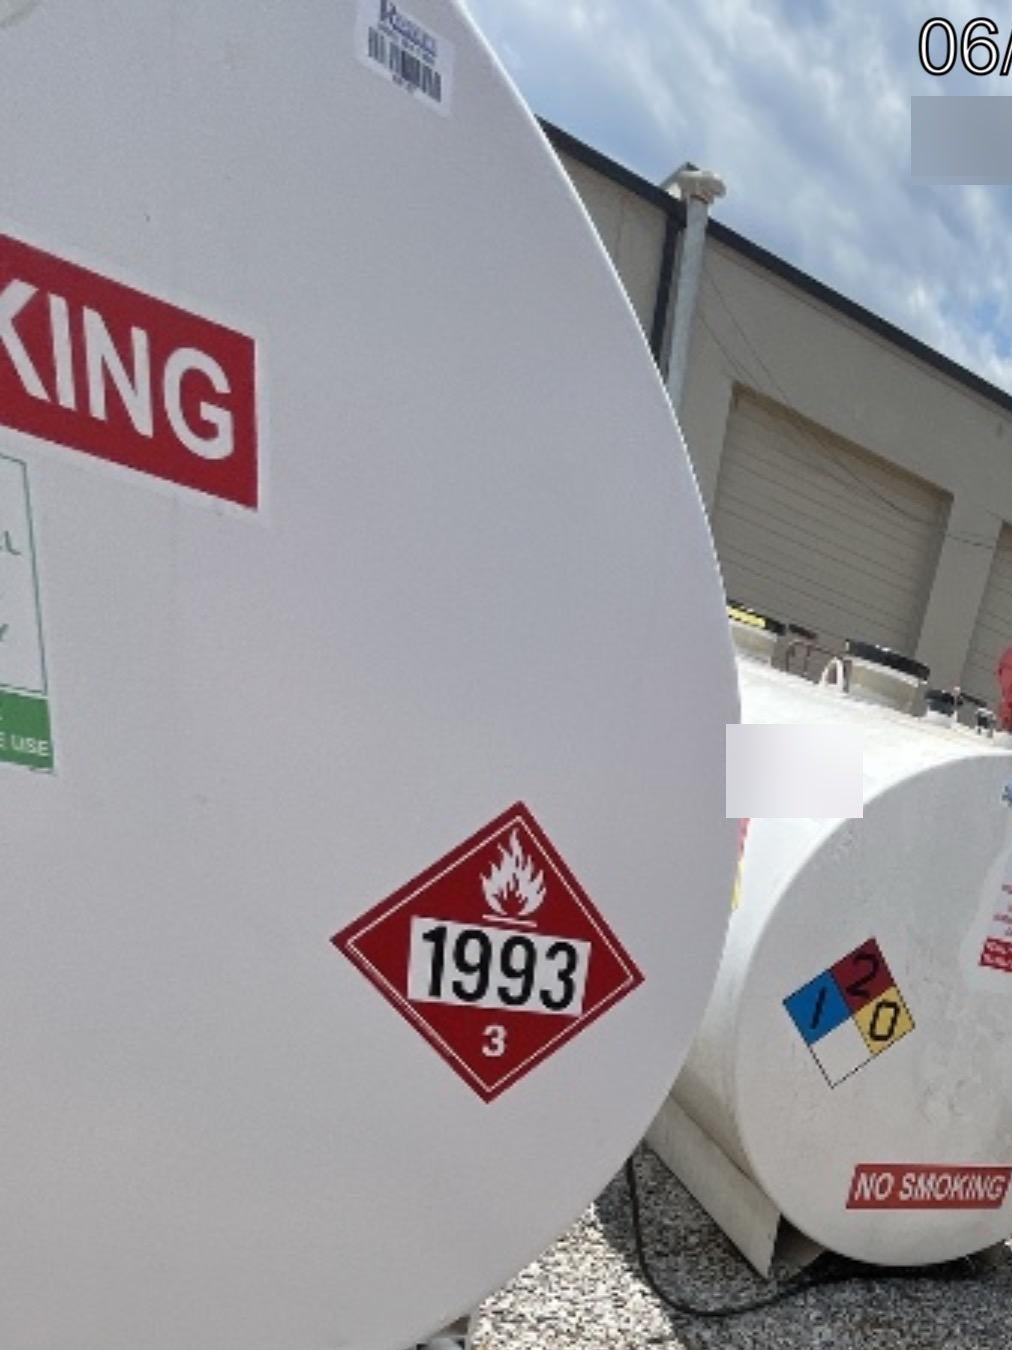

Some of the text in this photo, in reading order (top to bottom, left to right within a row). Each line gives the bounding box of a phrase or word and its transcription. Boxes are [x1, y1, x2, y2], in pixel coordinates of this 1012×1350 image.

[422, 926, 578, 1011] 1993
[846, 953, 881, 999] 2
[481, 1024, 507, 1057] 3
[869, 1000, 900, 1041] 0
[854, 1172, 1006, 1202] NO SMOKING
